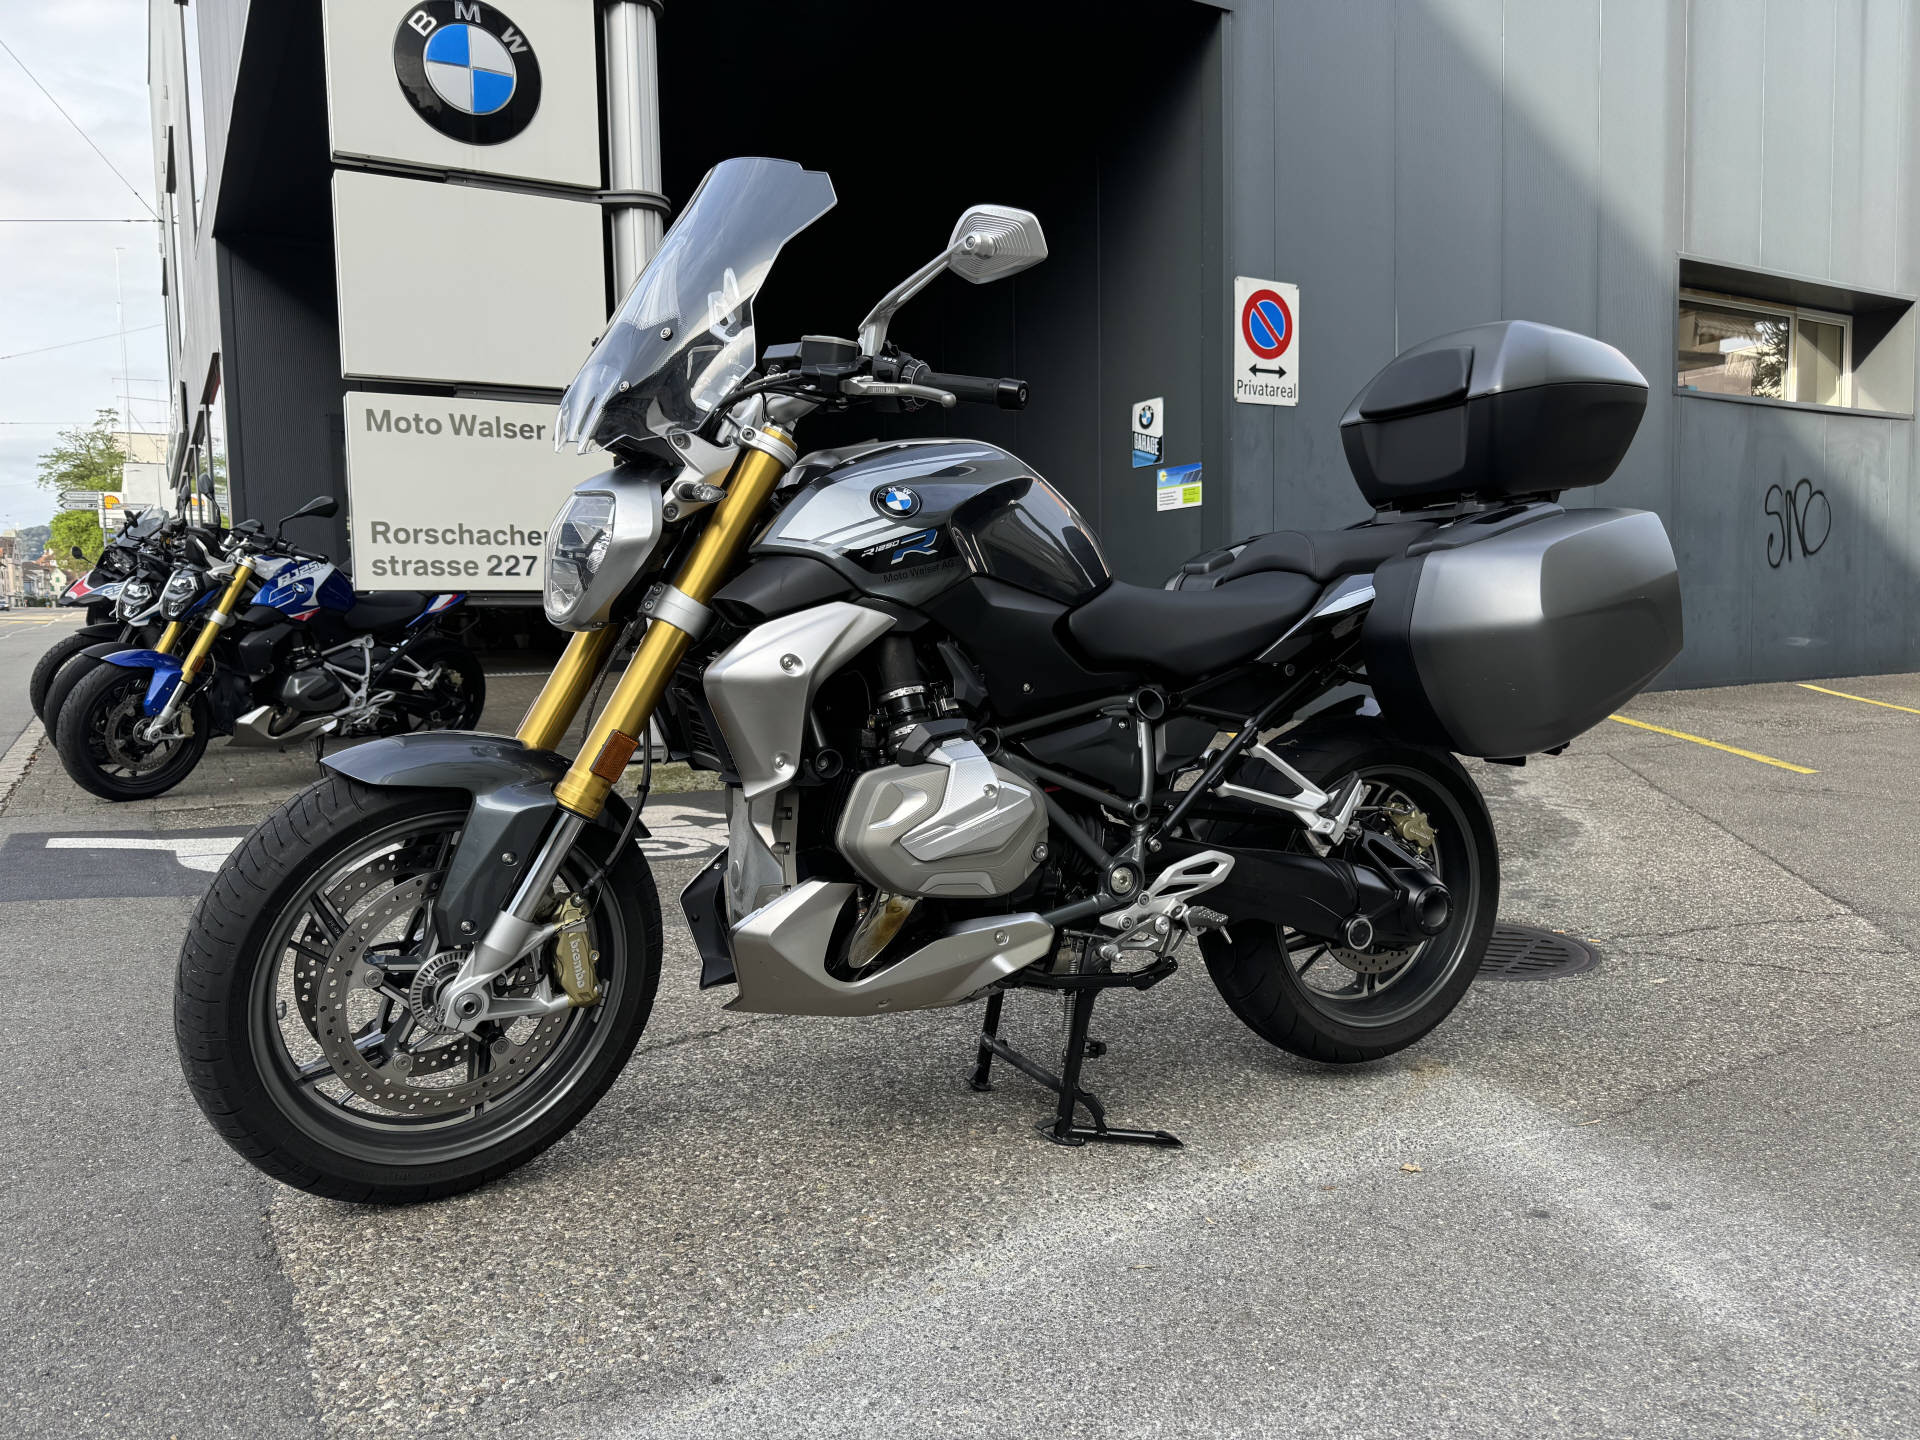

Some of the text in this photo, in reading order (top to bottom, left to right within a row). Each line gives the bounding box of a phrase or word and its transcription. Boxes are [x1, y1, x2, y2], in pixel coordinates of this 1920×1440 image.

[407, 1, 528, 54] BMW
[1236, 379, 1297, 399] Privatareal
[365, 408, 547, 441] Moto Walser
[1134, 432, 1160, 456] GARAGE
[371, 554, 538, 577] strasse 227
[570, 938, 585, 988] brembo
